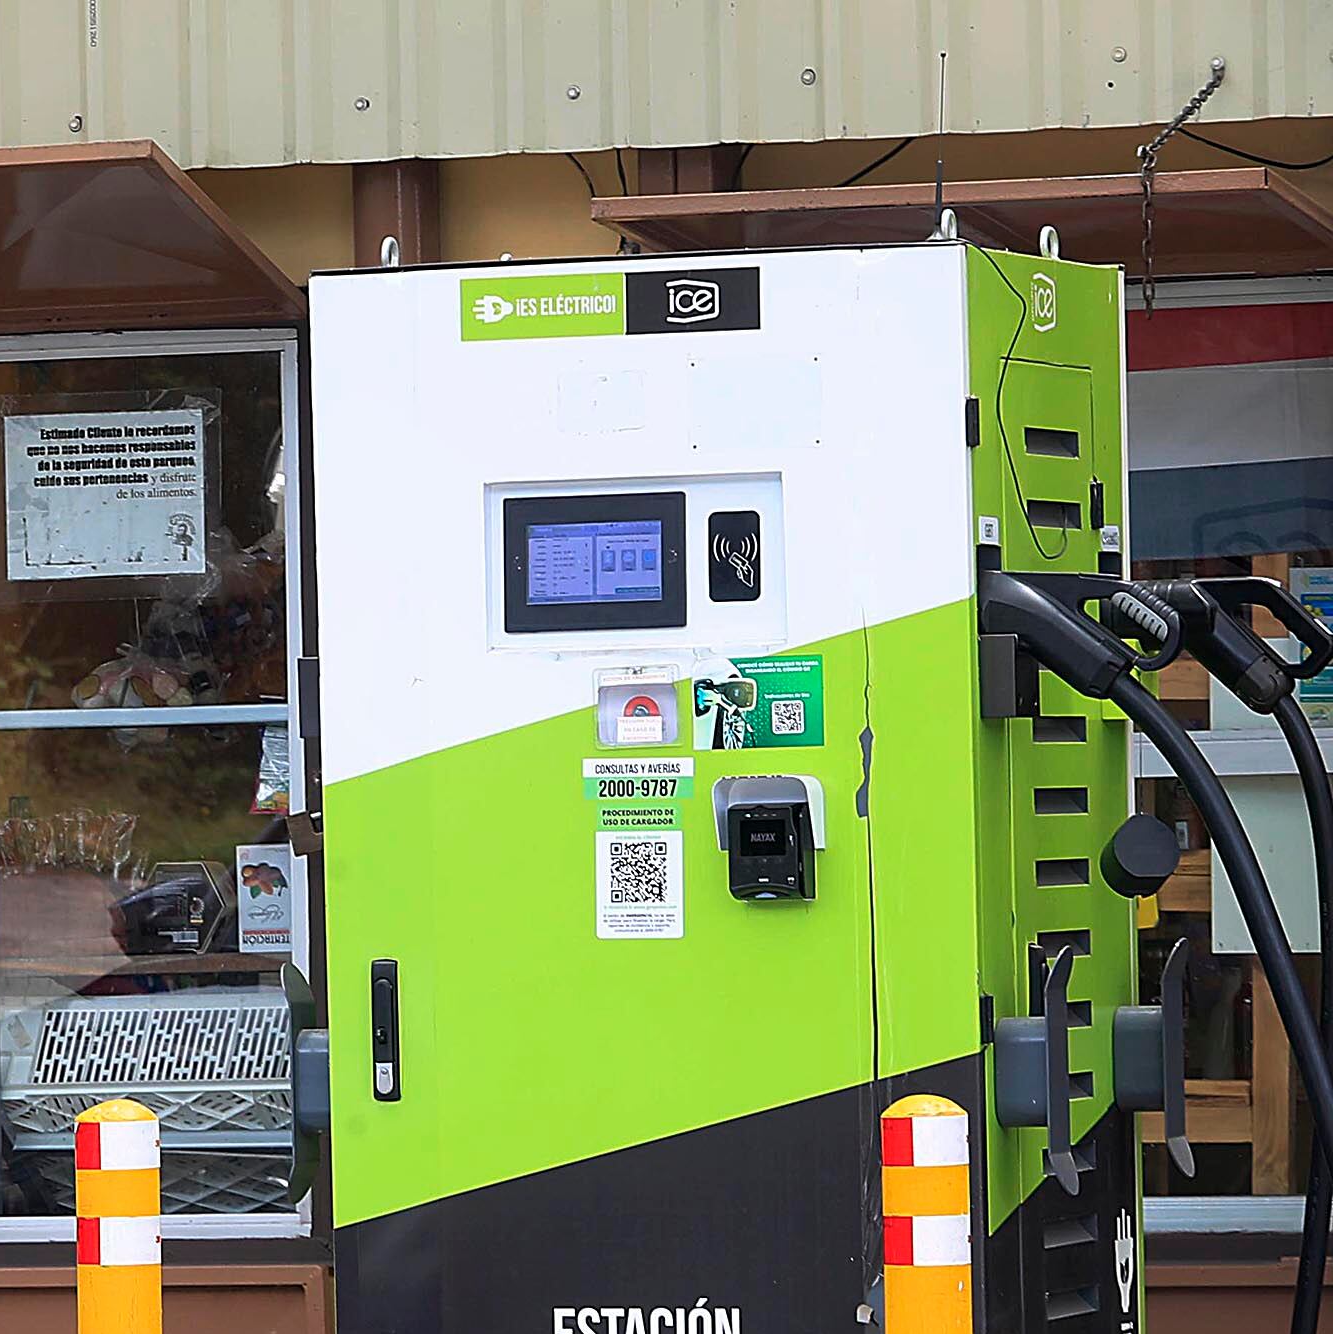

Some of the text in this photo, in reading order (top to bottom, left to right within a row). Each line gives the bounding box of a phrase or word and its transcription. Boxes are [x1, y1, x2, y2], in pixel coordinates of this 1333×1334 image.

[540, 292, 617, 316] ELÉCTRICO!
[668, 288, 713, 314] ice
[40, 428, 85, 440] Estimado
[87, 427, 123, 439] Cliente
[135, 424, 195, 437] recordamos
[27, 440, 196, 456] que no nos hacemos responsables
[37, 460, 51, 471] de
[52, 460, 62, 470] la
[63, 457, 114, 471] seguridad
[115, 457, 128, 468] de
[129, 458, 151, 468] este
[63, 476, 81, 486] sus
[83, 473, 148, 487] pertenencias
[150, 475, 158, 485] y
[159, 472, 197, 483] disfrute
[116, 487, 197, 499] de los alimentos.
[595, 761, 681, 775] CONSULTAS Y AVERÍAS
[598, 779, 677, 797] 2000-9787
[602, 809, 663, 817] PROCEDIMIENTO
[631, 818, 674, 826] CARGADOR
[750, 832, 776, 843] NAYAX
